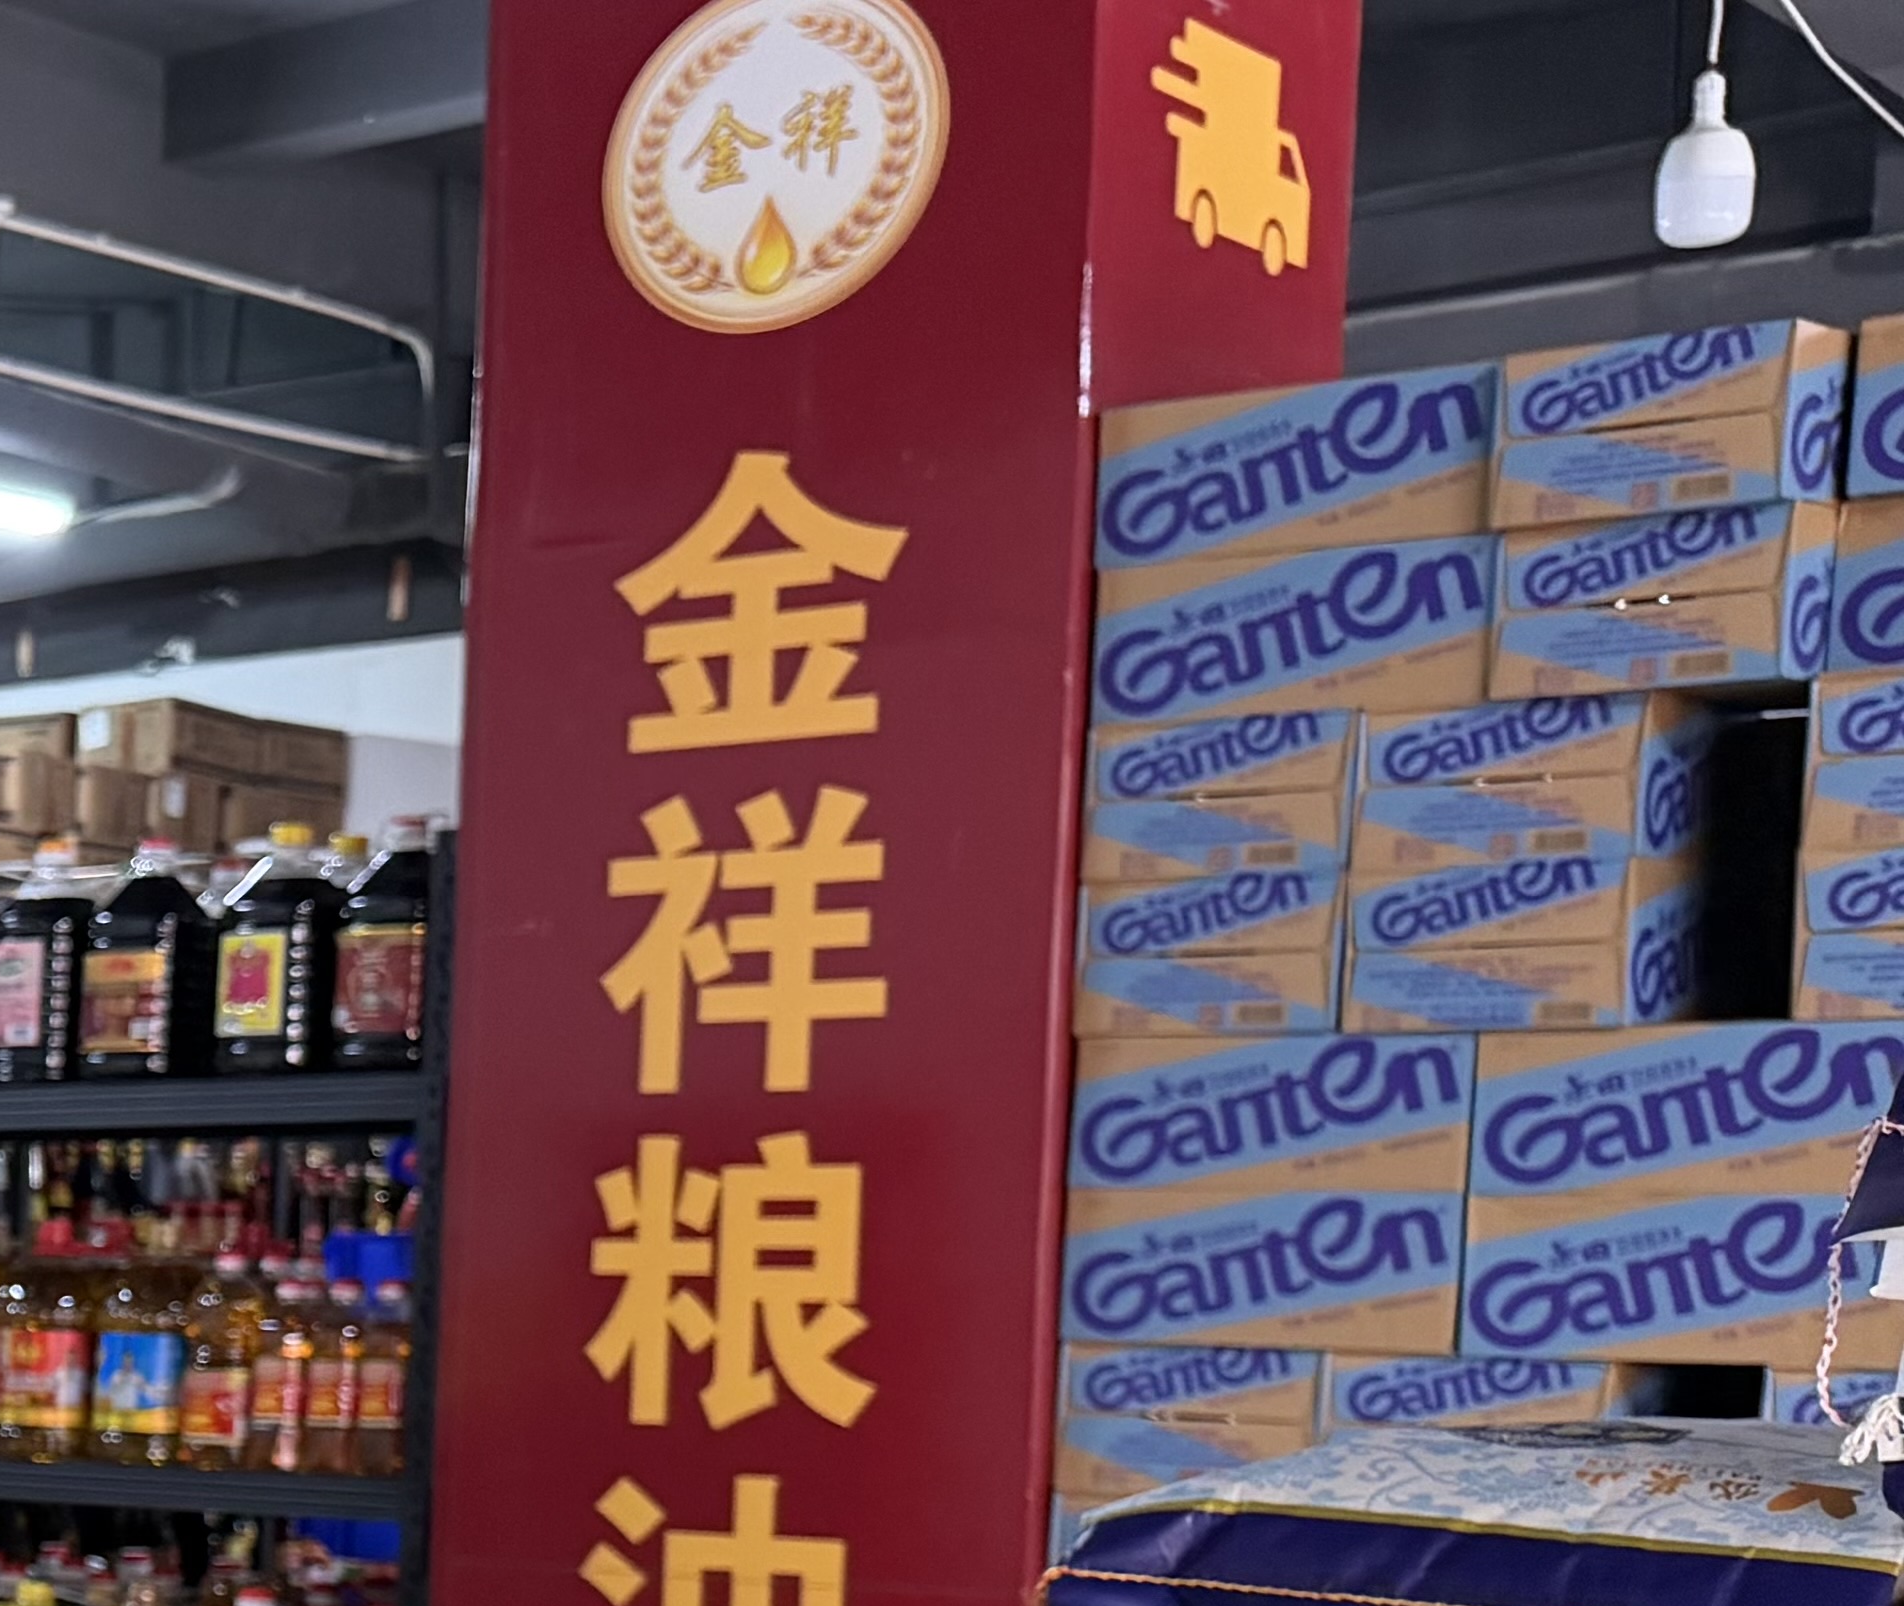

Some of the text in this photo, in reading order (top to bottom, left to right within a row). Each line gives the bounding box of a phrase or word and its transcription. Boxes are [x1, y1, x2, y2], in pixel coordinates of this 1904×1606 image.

[681, 84, 862, 192] 金祥
[1521, 325, 1754, 434] Ganten
[1100, 382, 1482, 556] Ganten
[1523, 508, 1756, 608] Ganten
[1097, 551, 1484, 716] Ganten
[1108, 712, 1322, 798] Ganten
[1382, 695, 1612, 785] Ganten
[1100, 872, 1313, 957] Ganten
[1370, 856, 1601, 948] Ganten
[1078, 1037, 1460, 1183] Ganten
[1071, 1198, 1448, 1335] Ganten
